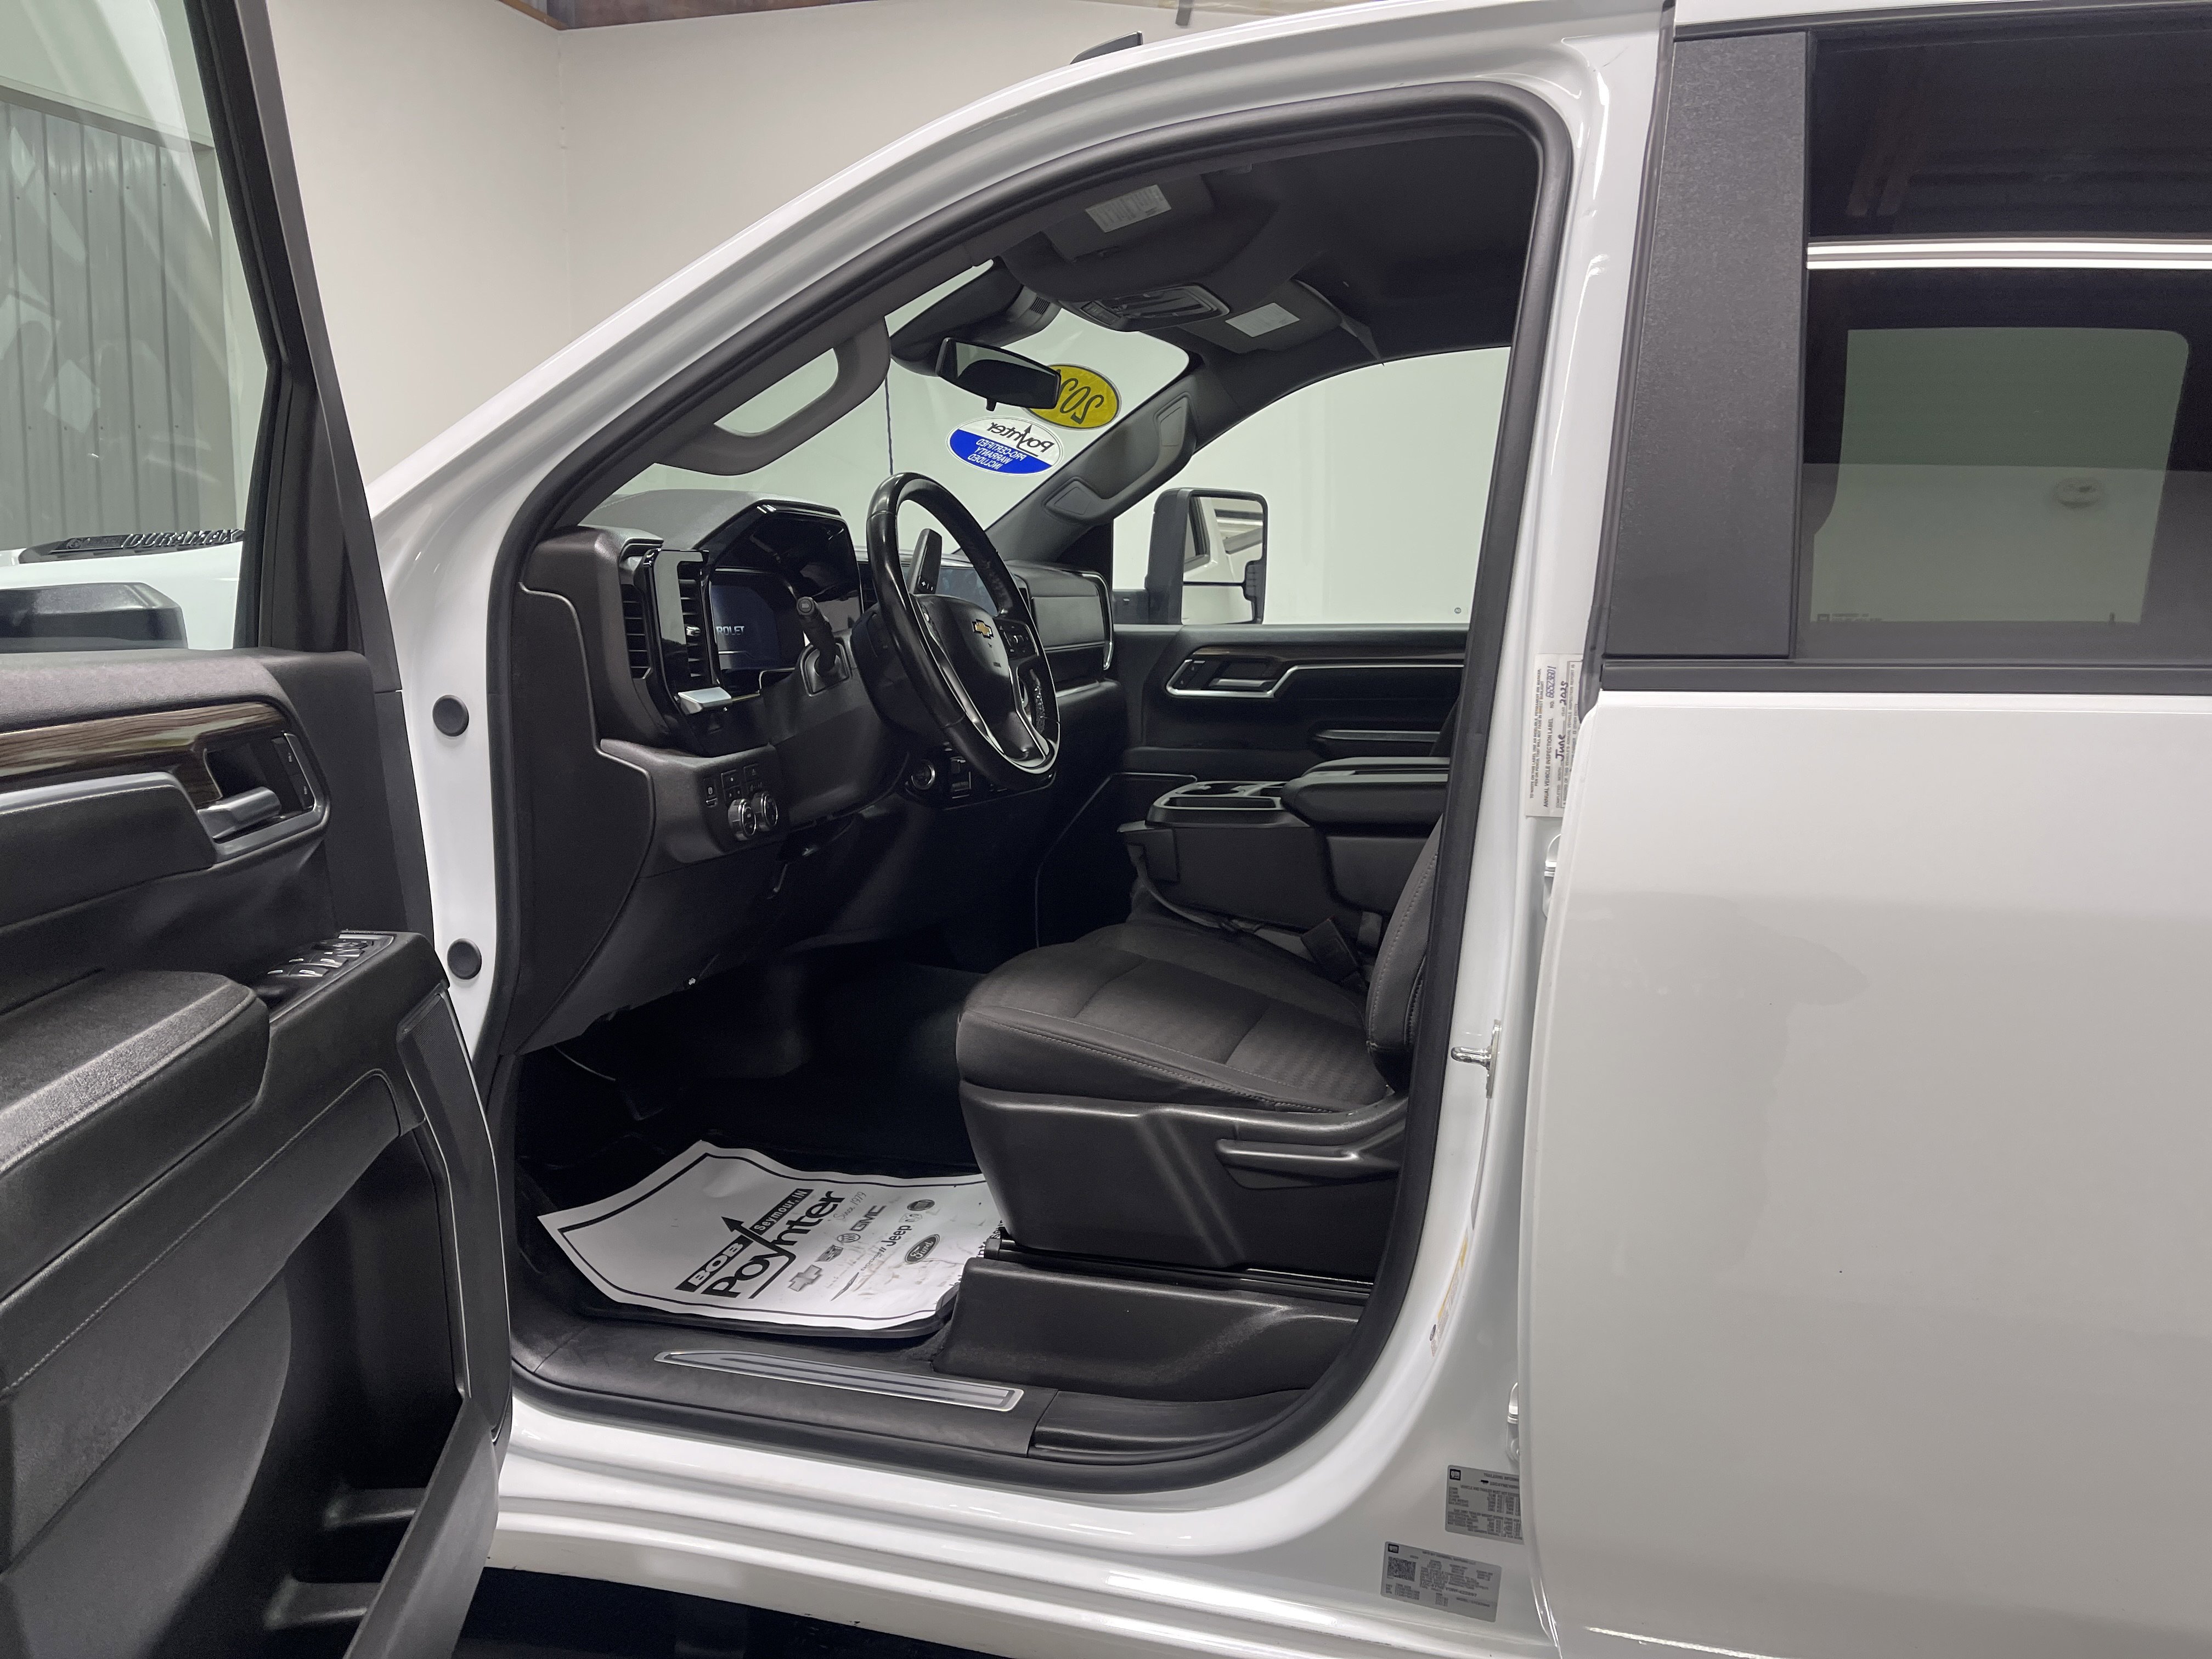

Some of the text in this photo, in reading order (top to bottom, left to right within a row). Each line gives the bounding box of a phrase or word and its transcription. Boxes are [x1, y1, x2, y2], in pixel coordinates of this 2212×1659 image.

[121, 528, 245, 549] DURAMAX
[1560, 681, 1568, 706] 2025
[1555, 735, 1565, 761] June
[850, 1191, 867, 1206] 1979
[850, 1205, 887, 1232] GMC
[687, 1189, 808, 1286] BOB Seymour, IN
[701, 1190, 845, 1299] Poynter
[881, 1225, 913, 1246] Jeep
[910, 1241, 934, 1259] Ford
